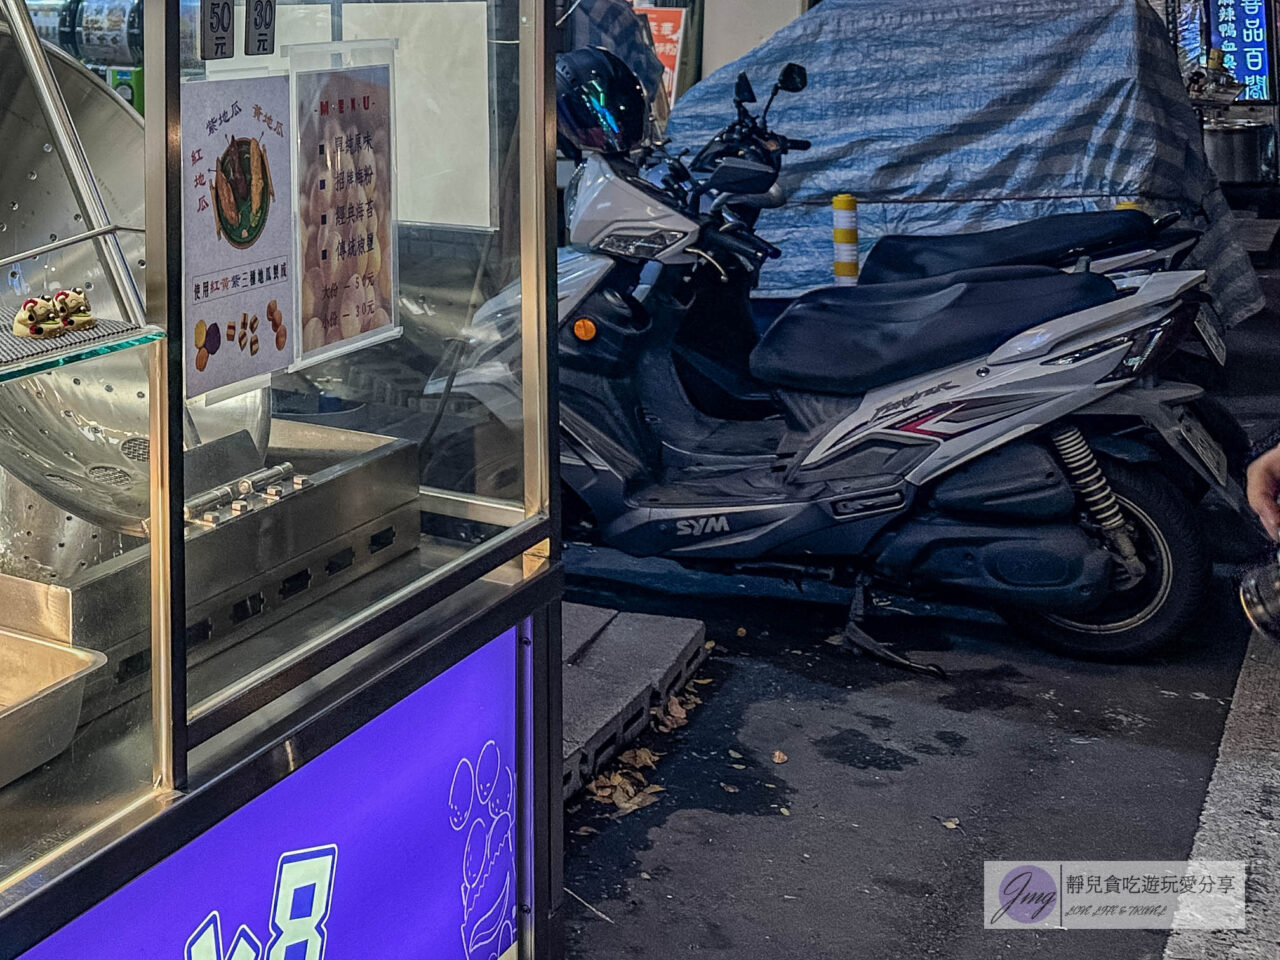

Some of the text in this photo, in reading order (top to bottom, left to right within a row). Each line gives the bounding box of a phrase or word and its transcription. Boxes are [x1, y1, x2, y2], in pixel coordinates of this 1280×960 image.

[206, 100, 242, 136] 紫地瓜
[191, 148, 209, 212] 紅地瓜
[676, 516, 730, 536] SYM
